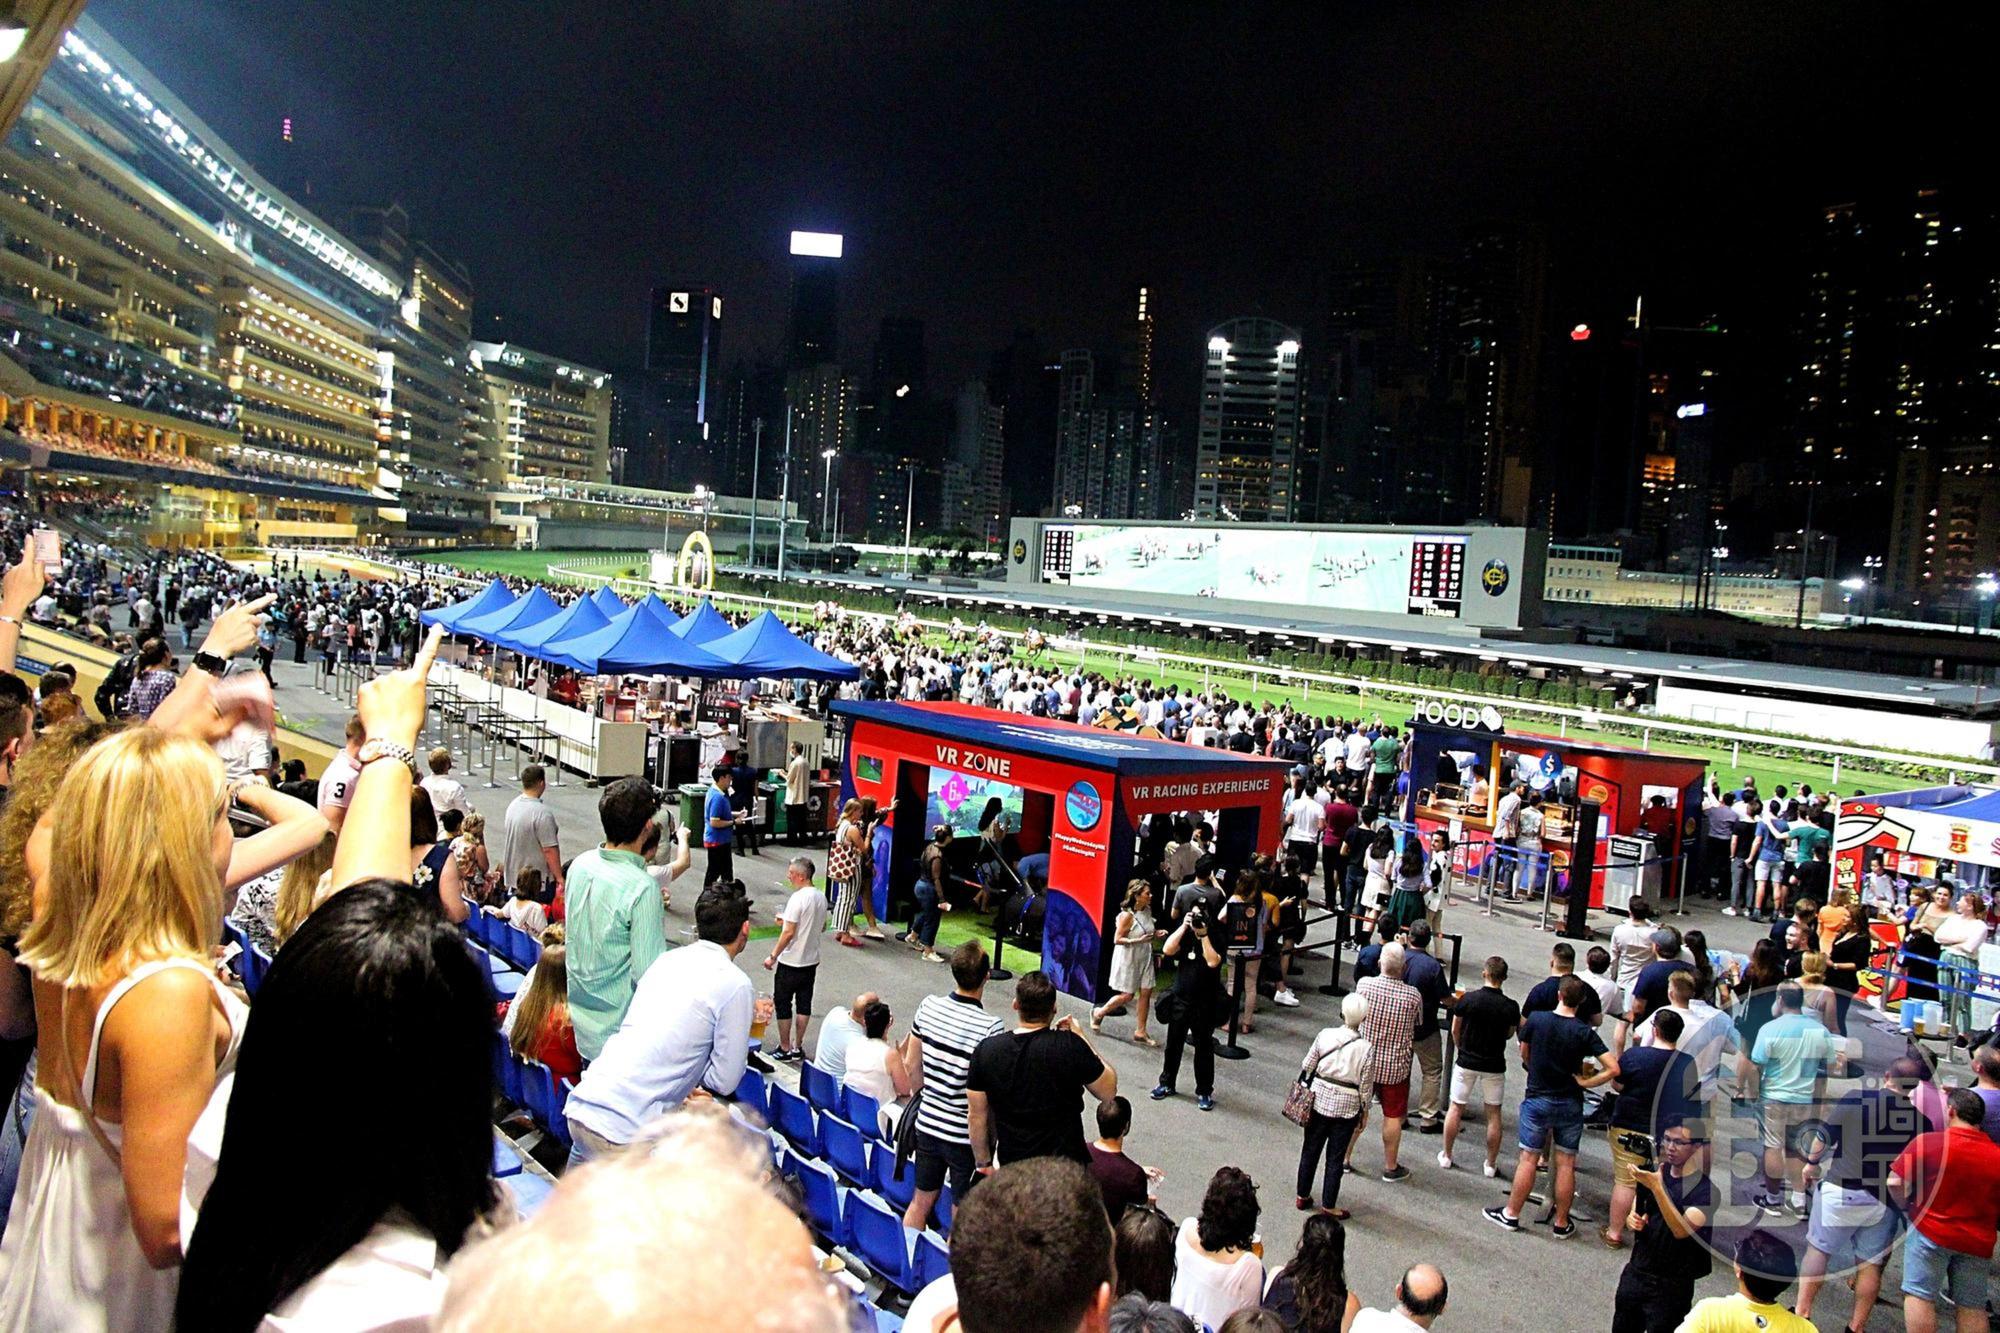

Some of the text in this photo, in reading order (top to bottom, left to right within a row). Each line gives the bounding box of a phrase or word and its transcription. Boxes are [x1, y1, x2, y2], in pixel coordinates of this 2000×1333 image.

[706, 710, 730, 718] WINE
[1411, 697, 1480, 729] FOOD
[936, 745, 1010, 777] VR ZONE
[334, 782, 346, 798] 3
[1132, 778, 1270, 800] VR RACING EXPERIENCE
[1236, 920, 1248, 931] IN
